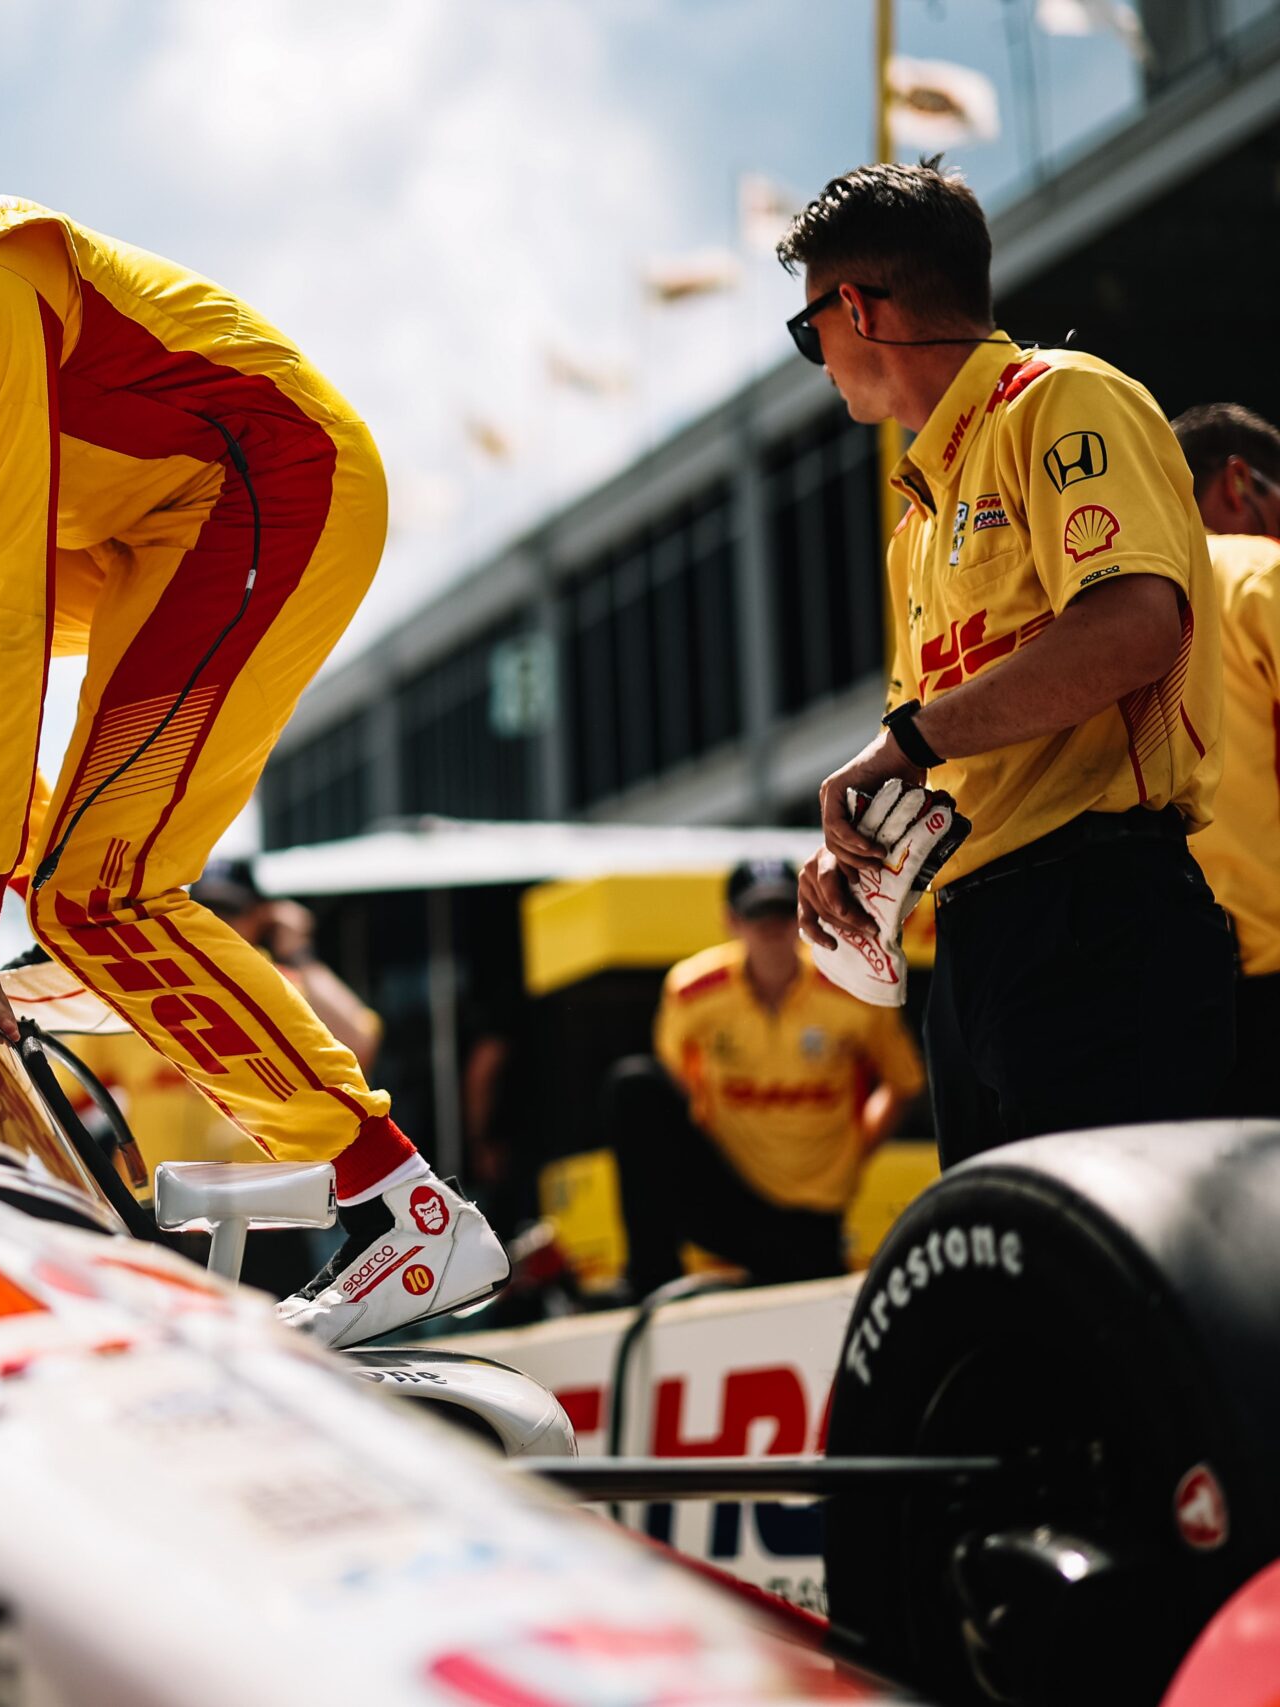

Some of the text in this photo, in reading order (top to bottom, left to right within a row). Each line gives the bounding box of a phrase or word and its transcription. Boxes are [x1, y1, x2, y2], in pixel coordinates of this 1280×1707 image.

[943, 405, 976, 472] DHL
[54, 886, 263, 1075] DHL
[342, 1245, 398, 1296] sparco
[406, 1267, 429, 1292] 10
[845, 1226, 1022, 1385] Firestone
